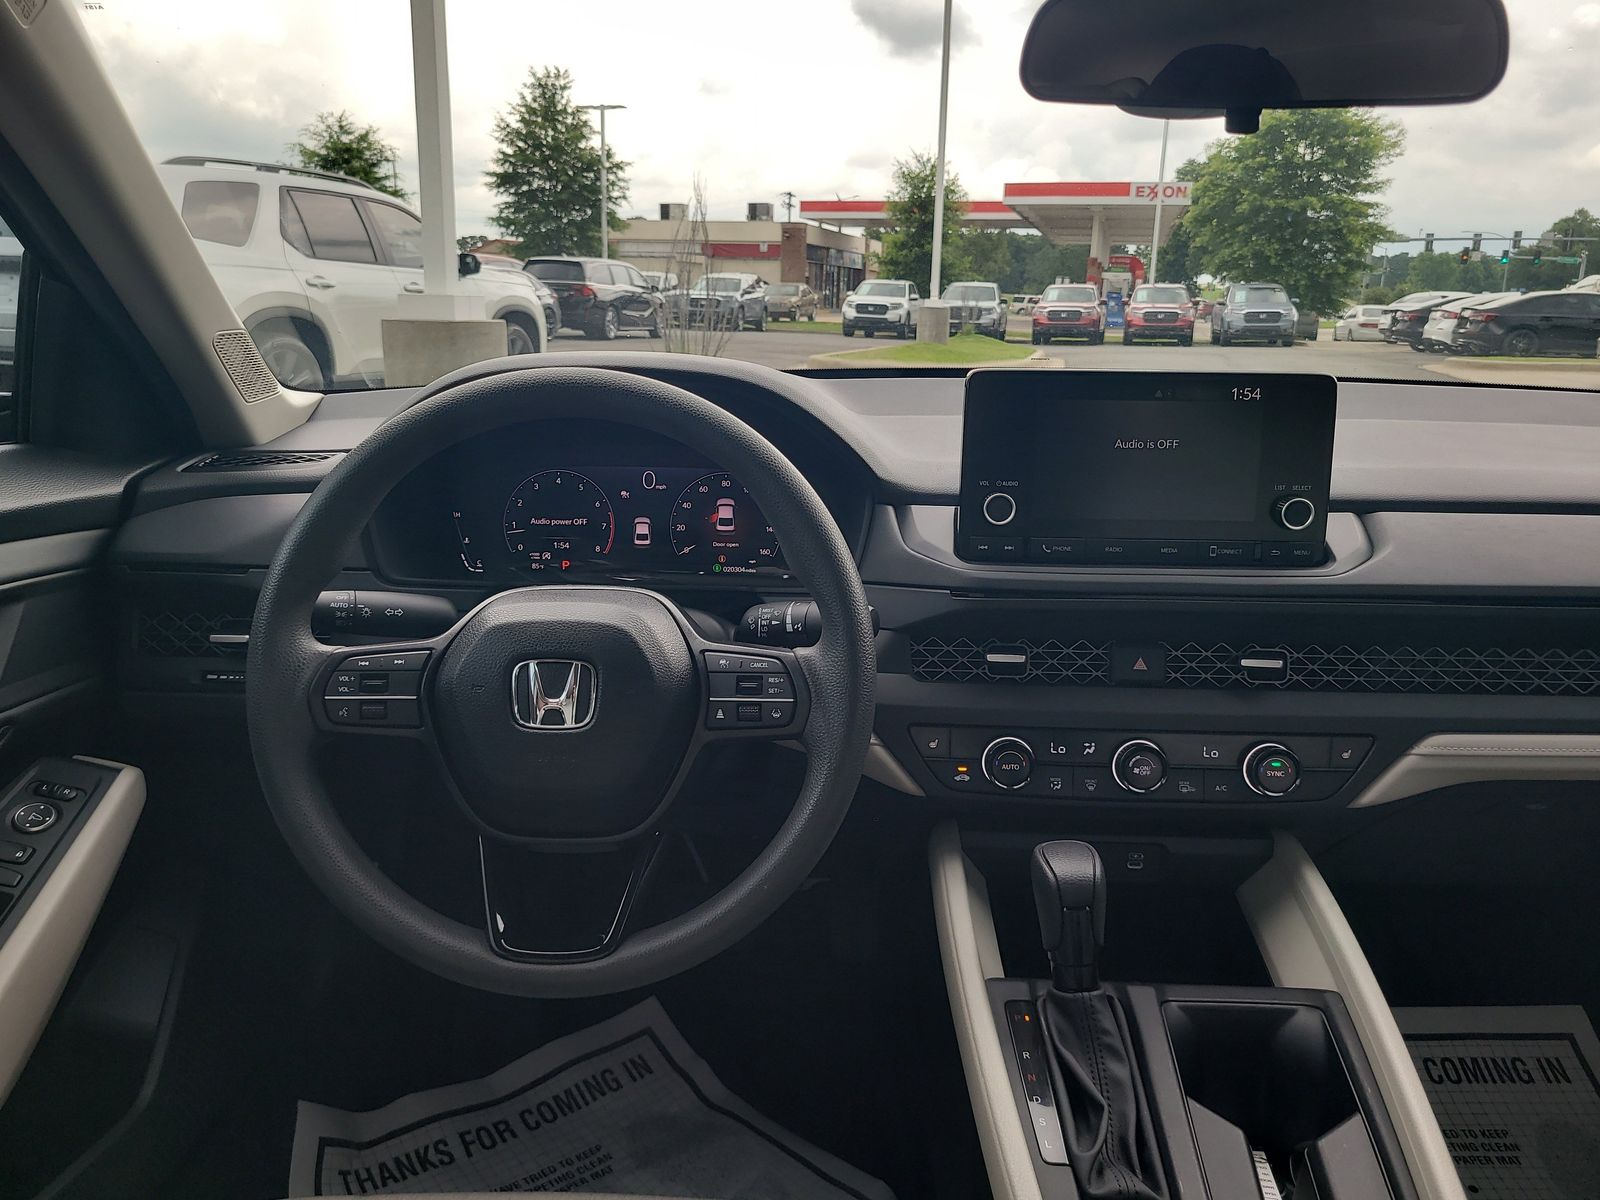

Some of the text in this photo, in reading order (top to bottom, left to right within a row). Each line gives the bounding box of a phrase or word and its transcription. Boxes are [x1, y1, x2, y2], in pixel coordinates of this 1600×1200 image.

[1231, 387, 1262, 401] 1:54
[1114, 439, 1180, 449] Audio is OFF
[556, 477, 562, 485] 4
[642, 470, 656, 490] 0
[530, 517, 550, 525] Audio
[551, 518, 572, 527] power
[562, 560, 570, 570] P
[1050, 742, 1066, 754] Lo
[1203, 746, 1219, 758] Lo
[1002, 763, 1020, 771] AUTO
[1022, 1051, 1031, 1060] R
[1422, 1056, 1572, 1085] COMING IN
[1027, 1074, 1036, 1082] N
[1033, 1095, 1041, 1104] D
[337, 1054, 655, 1196] THANKS FOR COMING IN
[1039, 1117, 1047, 1126] S
[1460, 1129, 1479, 1139] TO
[1478, 1129, 1509, 1139] KEEP
[1045, 1140, 1052, 1149] L
[1480, 1142, 1521, 1152] CLEAN
[522, 1165, 557, 1186] TRIED
[558, 1157, 575, 1169] TO
[575, 1144, 603, 1163] KEEP
[575, 1152, 614, 1175] CLEAN
[1453, 1156, 1522, 1166] PAPER MAT
[589, 1164, 615, 1181] MAT
